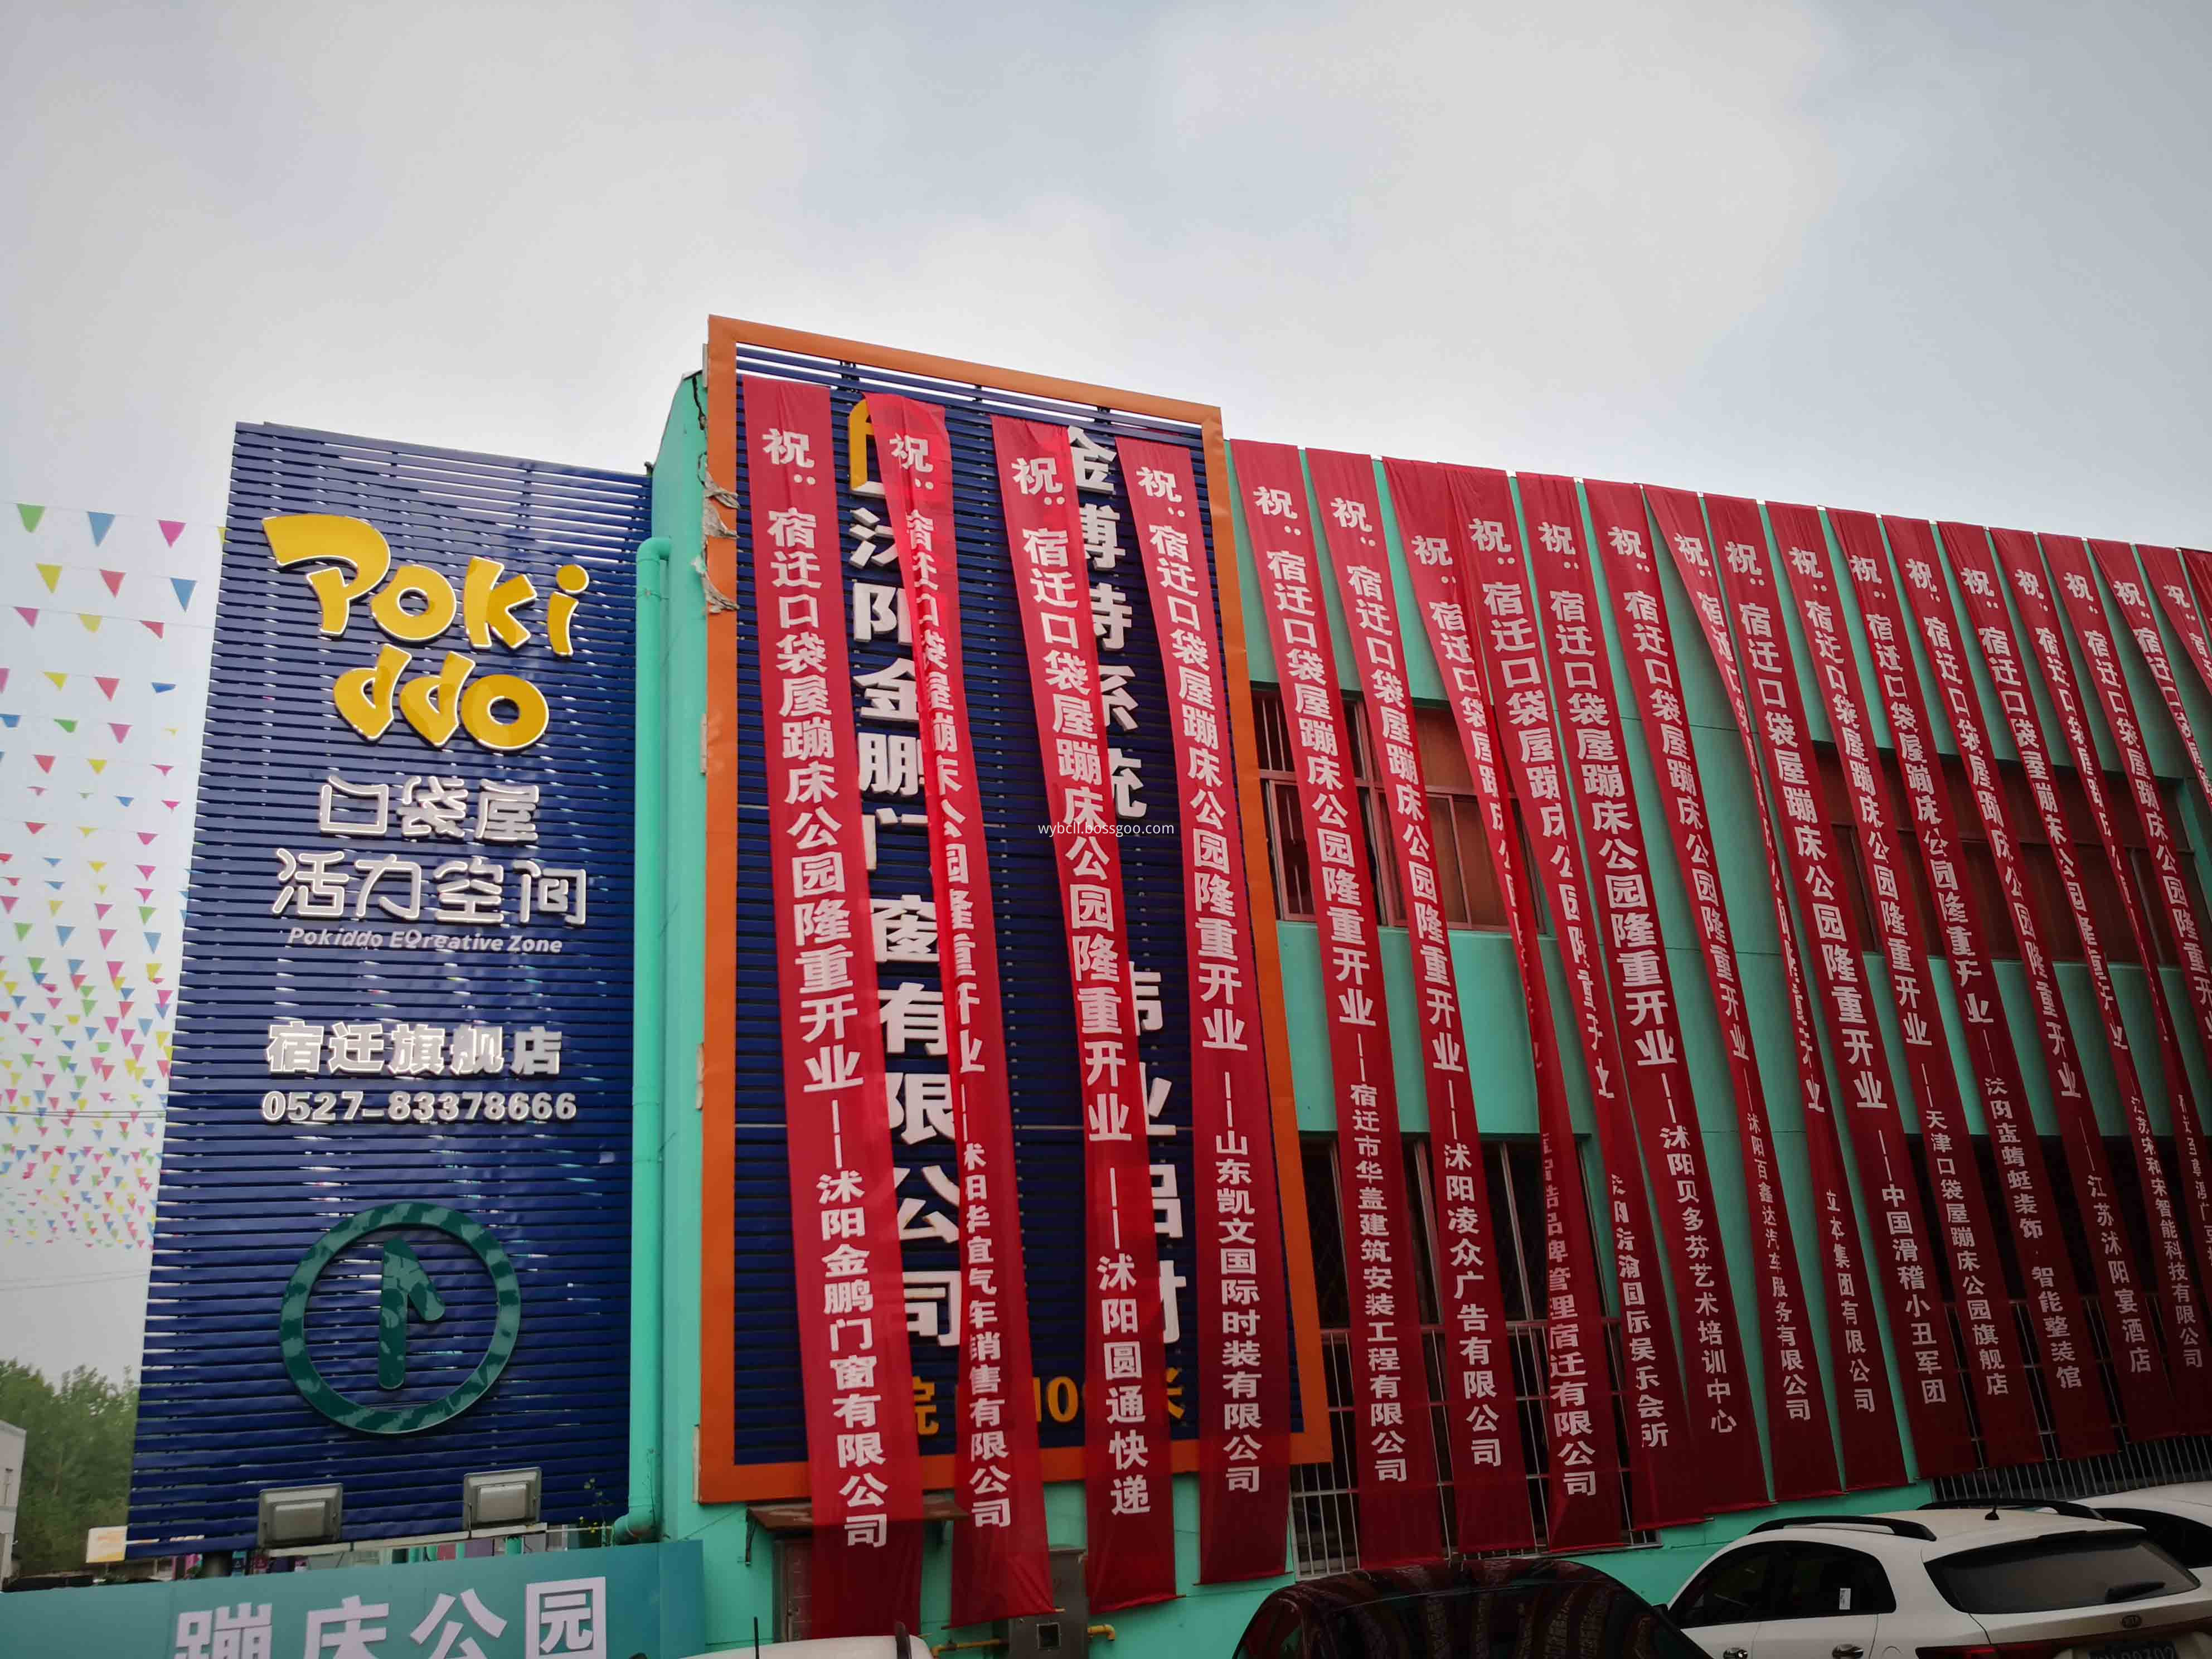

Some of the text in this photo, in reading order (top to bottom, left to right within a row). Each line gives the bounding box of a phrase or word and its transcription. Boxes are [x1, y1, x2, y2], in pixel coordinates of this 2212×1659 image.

[261, 514, 589, 657] Poki
[333, 644, 549, 750] ddo
[318, 775, 539, 842] 口袋屋
[271, 847, 590, 926] 活力空间
[287, 927, 384, 949] Pokiddo
[507, 935, 562, 953] Zone
[265, 1021, 562, 1076] 宿迁旗舰店
[261, 1090, 578, 1123] 0527-83378666
